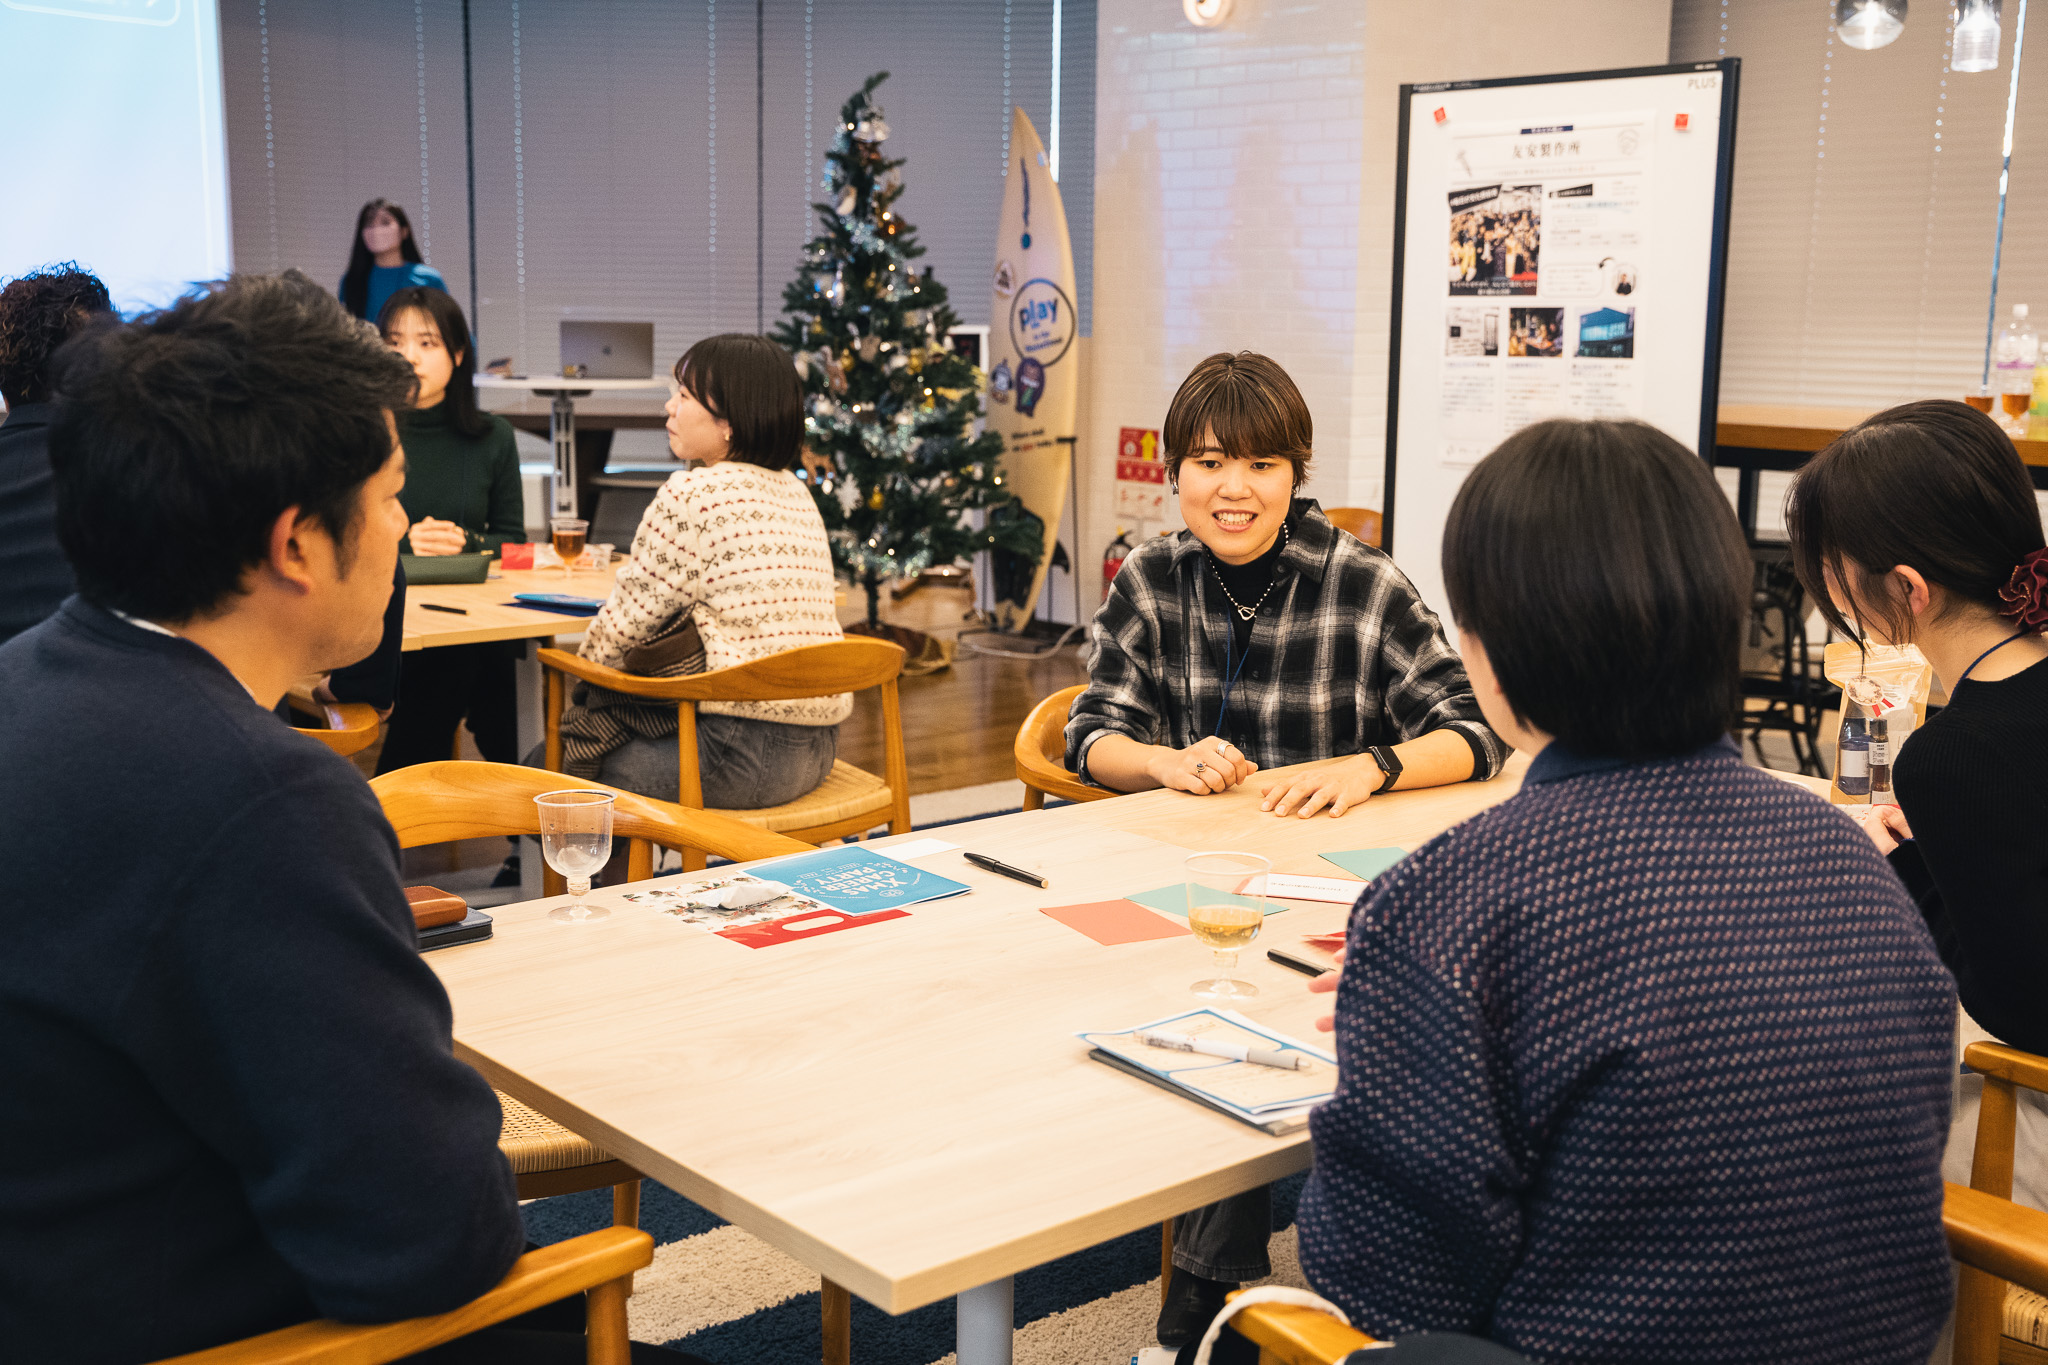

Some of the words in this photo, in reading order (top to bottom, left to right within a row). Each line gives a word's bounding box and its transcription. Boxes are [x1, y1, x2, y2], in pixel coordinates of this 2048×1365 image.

[1687, 76, 1717, 90] PLUS
[1512, 141, 1581, 160] 友安製作所
[1018, 297, 1058, 332] play
[815, 866, 877, 886] PARTY
[819, 870, 896, 891] CAREER
[842, 877, 908, 896] X'MAS
